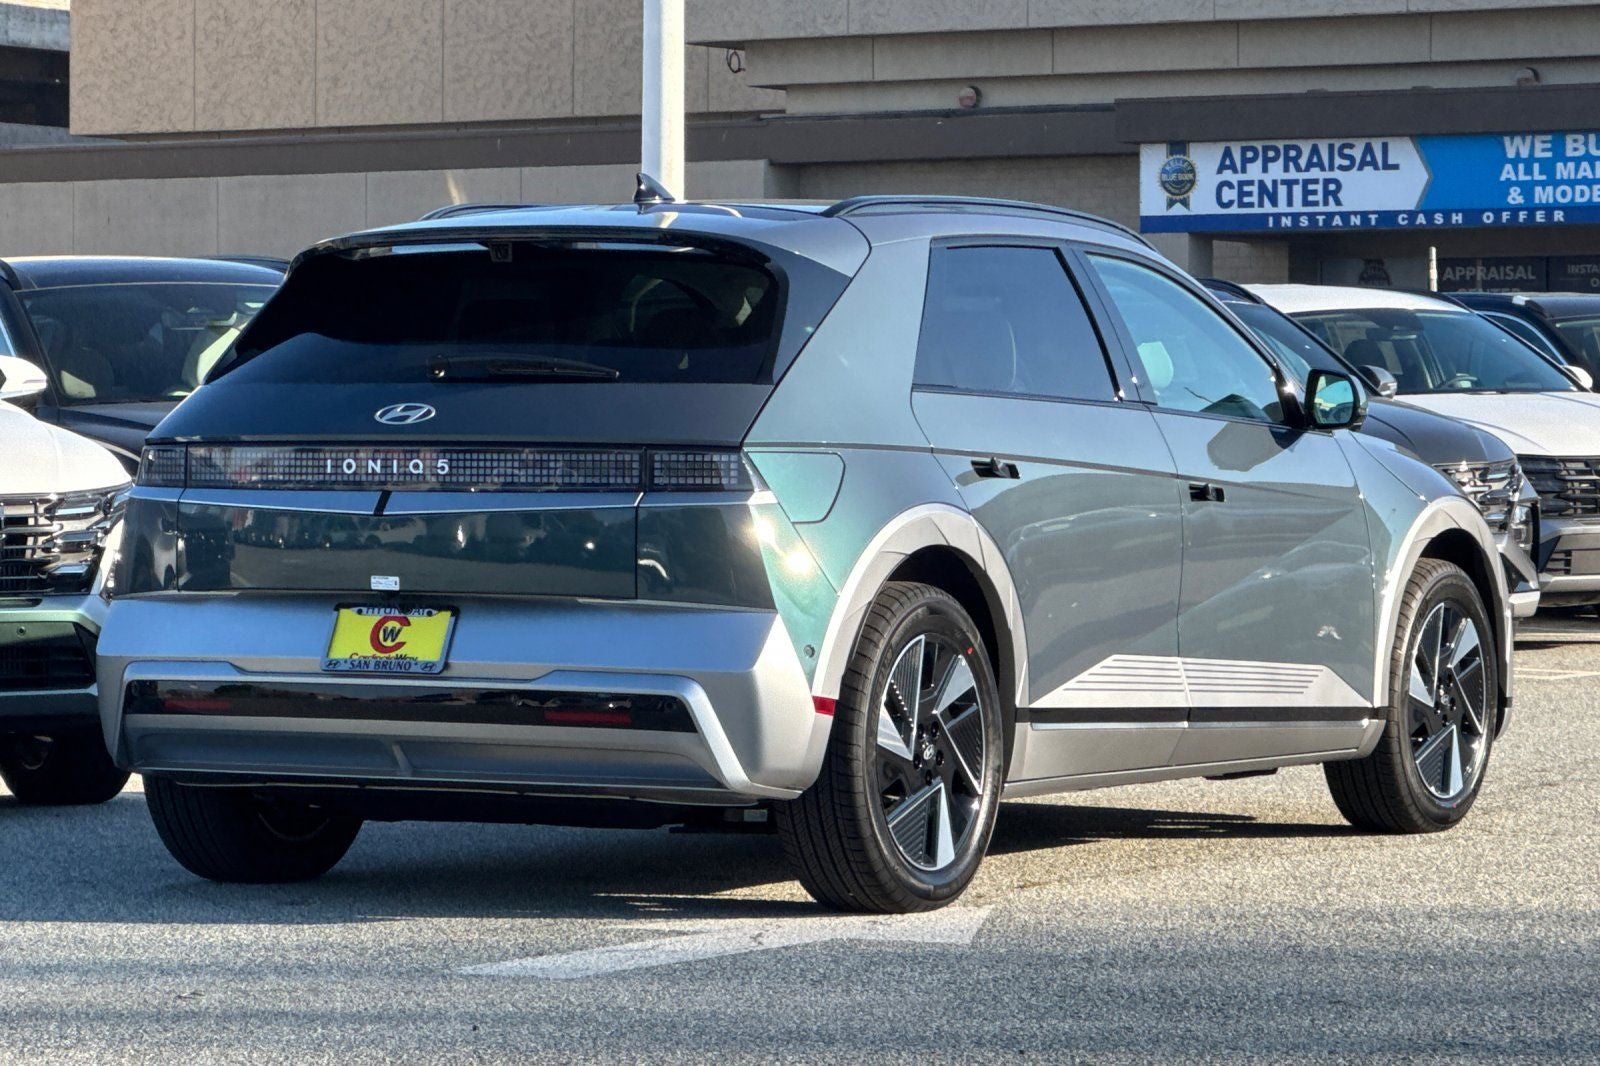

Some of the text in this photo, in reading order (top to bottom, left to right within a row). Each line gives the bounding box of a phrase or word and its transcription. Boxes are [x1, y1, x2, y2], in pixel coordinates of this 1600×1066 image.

[1503, 134, 1553, 159] WE
[1216, 141, 1400, 175] APPRAISAL
[1499, 162, 1547, 181] ALL
[1215, 178, 1344, 210] CENTER
[1507, 186, 1525, 205] &
[1268, 209, 1566, 228] INSTANT CASH OFFER
[1442, 264, 1537, 282] APPRAISAL
[349, 660, 412, 671] SAN BRUNO
